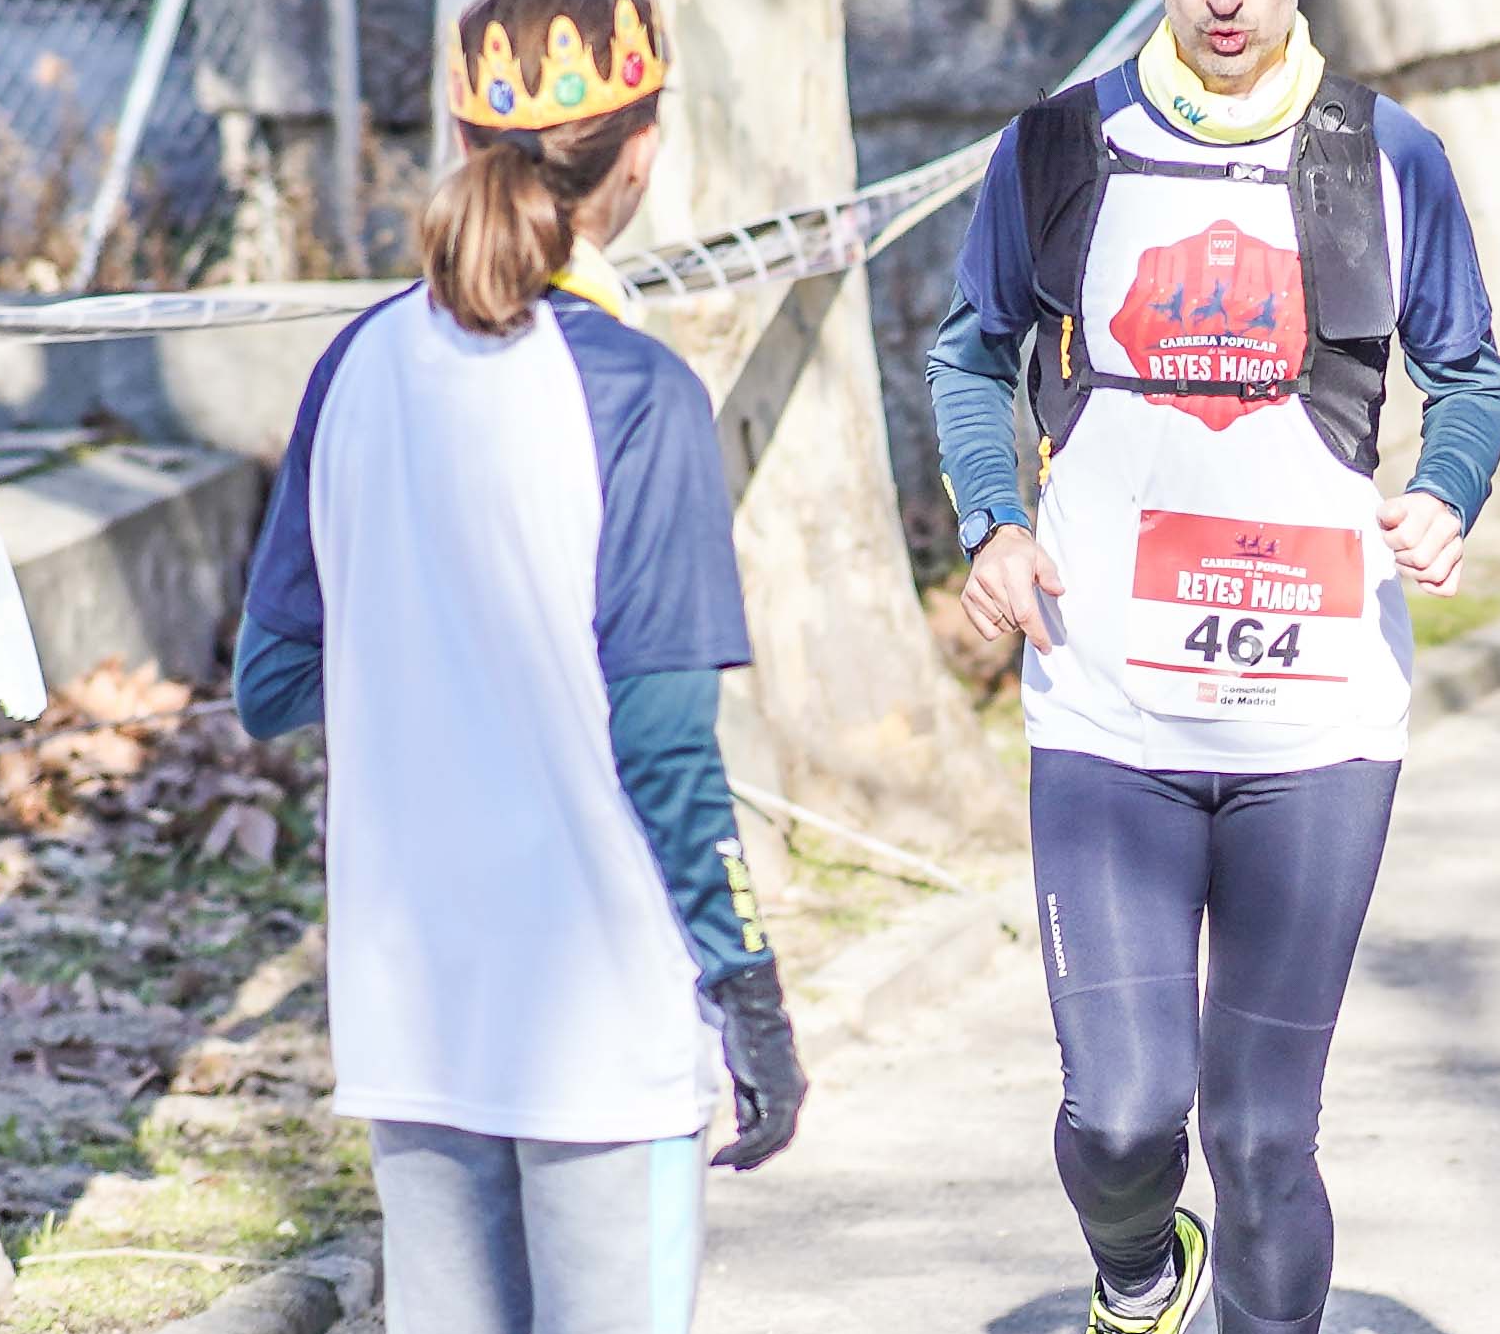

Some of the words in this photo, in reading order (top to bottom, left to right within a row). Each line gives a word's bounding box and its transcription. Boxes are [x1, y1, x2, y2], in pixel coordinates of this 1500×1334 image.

[1159, 335, 1220, 348] CARRERA
[1220, 336, 1277, 354] POPULAR
[1148, 354, 1211, 381] REYES
[1220, 355, 1288, 382] MAGOS
[1201, 558, 1254, 571] CARRERA
[1255, 561, 1307, 578] POPULAR
[1176, 570, 1244, 605] REYES
[1251, 578, 1323, 612] MAGOS
[1184, 615, 1301, 667] 464
[1220, 696, 1234, 705] de
[1237, 697, 1277, 706] Madrid
[1221, 685, 1277, 695] Comunidad
[1047, 893, 1068, 977] SALOMON
